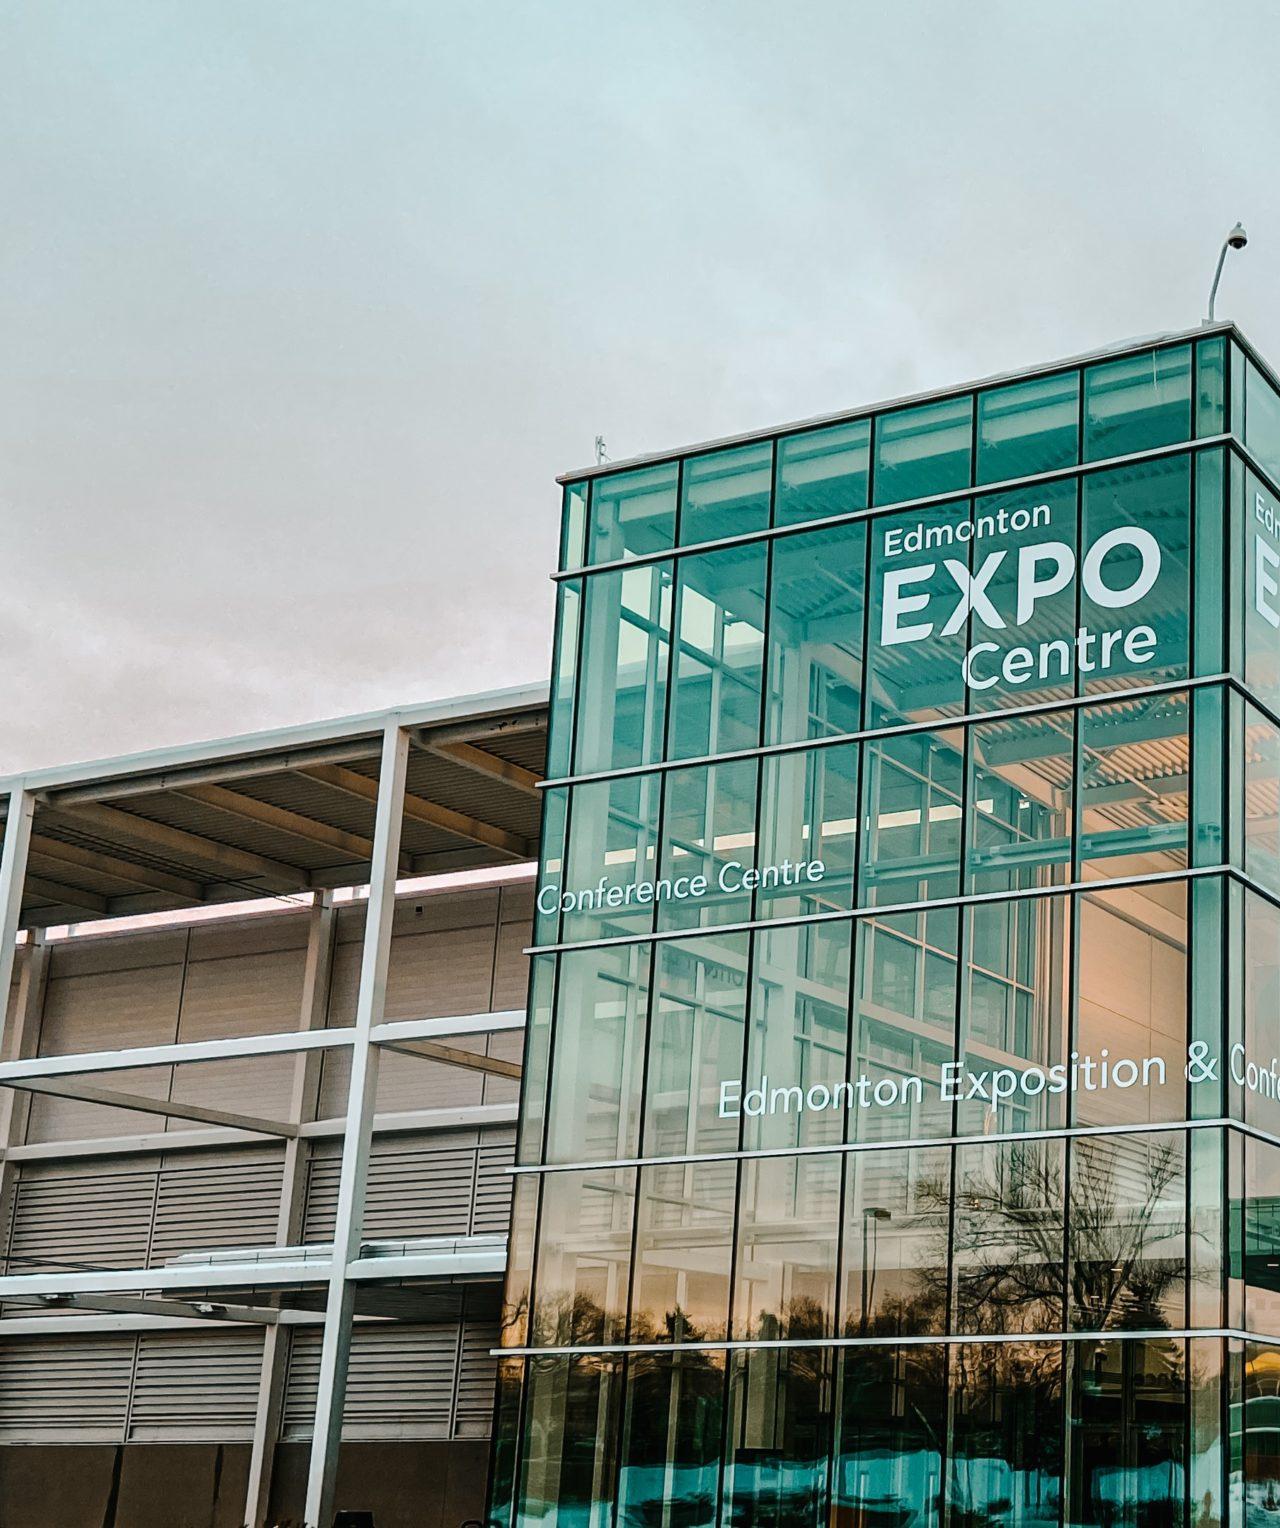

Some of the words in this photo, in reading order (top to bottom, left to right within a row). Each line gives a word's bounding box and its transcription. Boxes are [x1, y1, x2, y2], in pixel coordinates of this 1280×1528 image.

[884, 504, 1051, 558] Edmonton
[880, 526, 1162, 647] EXPO
[961, 624, 1158, 690] Centre
[536, 874, 708, 915] Conference
[718, 859, 826, 893] Centre
[718, 1074, 923, 1118] Edmonton
[940, 1048, 1166, 1113] Exposition
[1184, 1040, 1219, 1083] &
